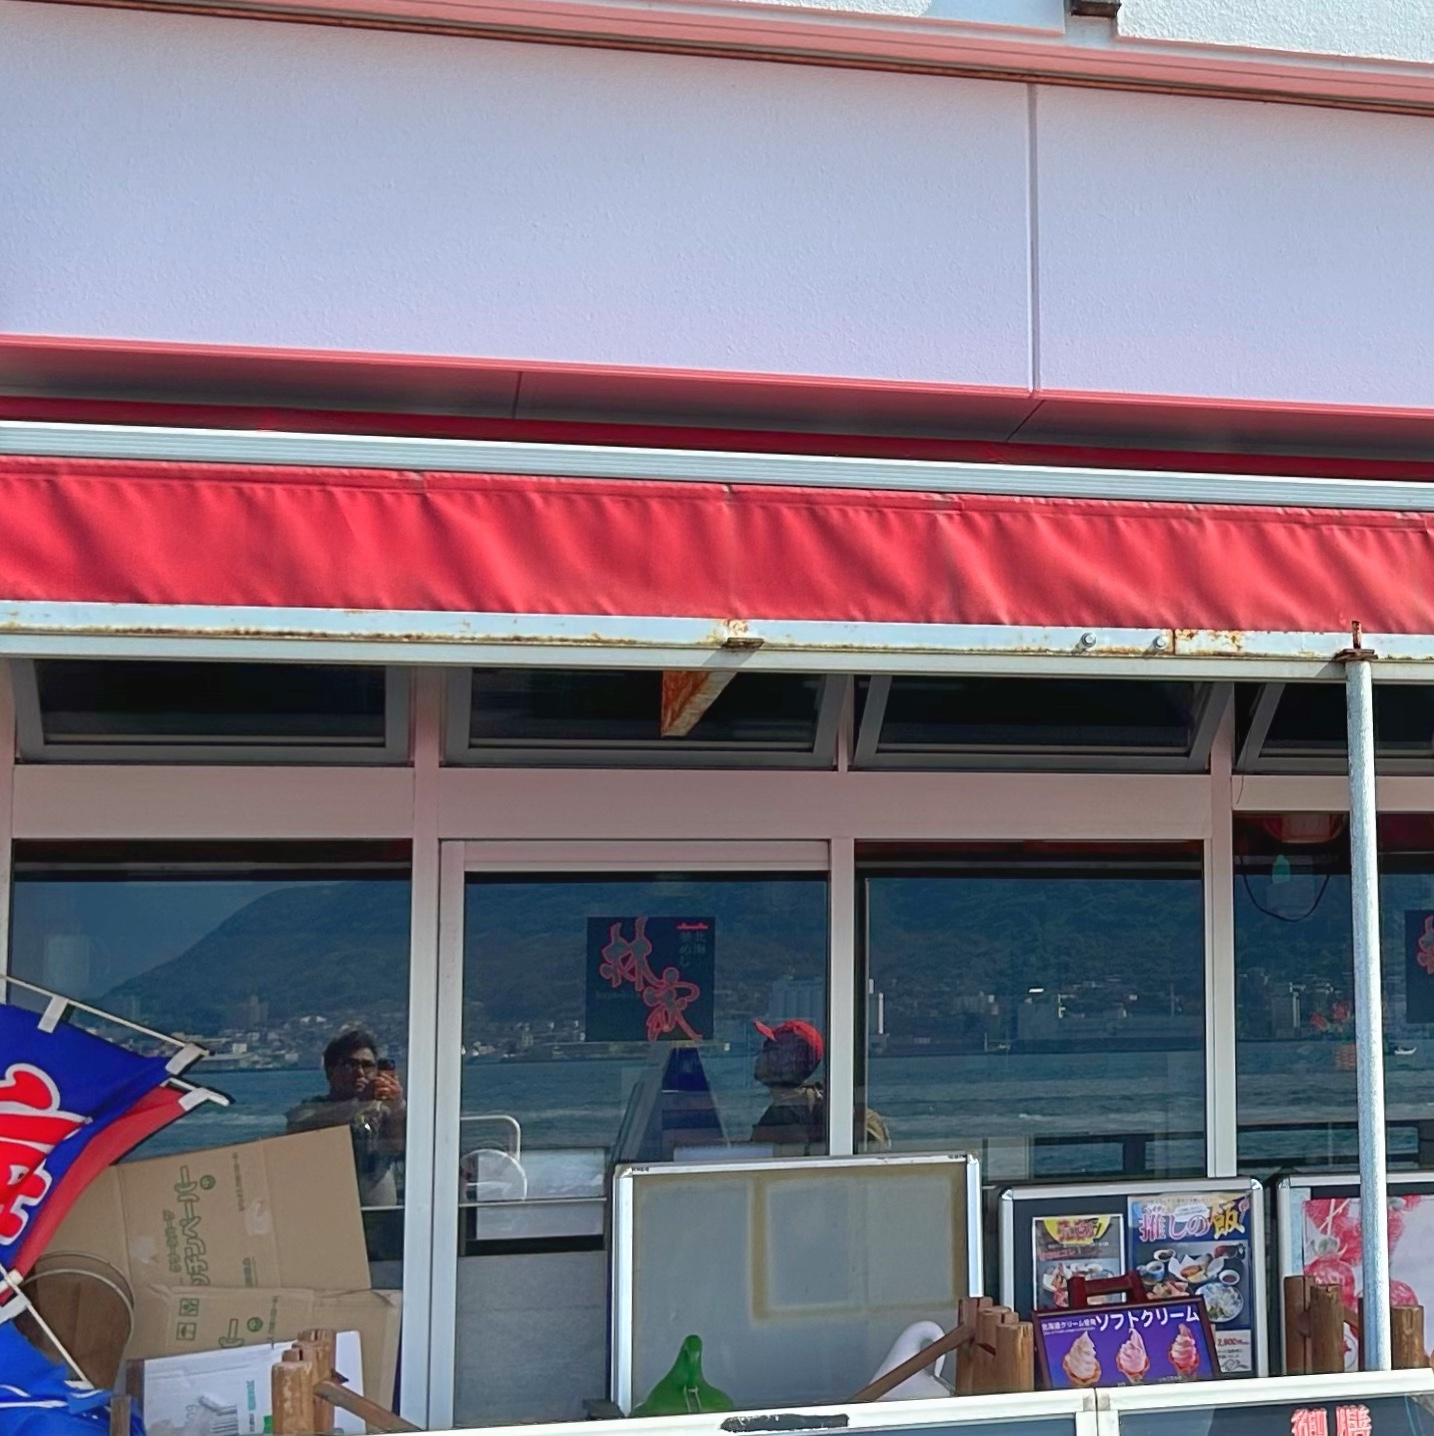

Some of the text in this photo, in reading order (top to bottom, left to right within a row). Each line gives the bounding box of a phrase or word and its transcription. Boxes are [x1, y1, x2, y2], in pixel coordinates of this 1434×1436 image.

[1095, 1305, 1200, 1331] ソフトクリーム
